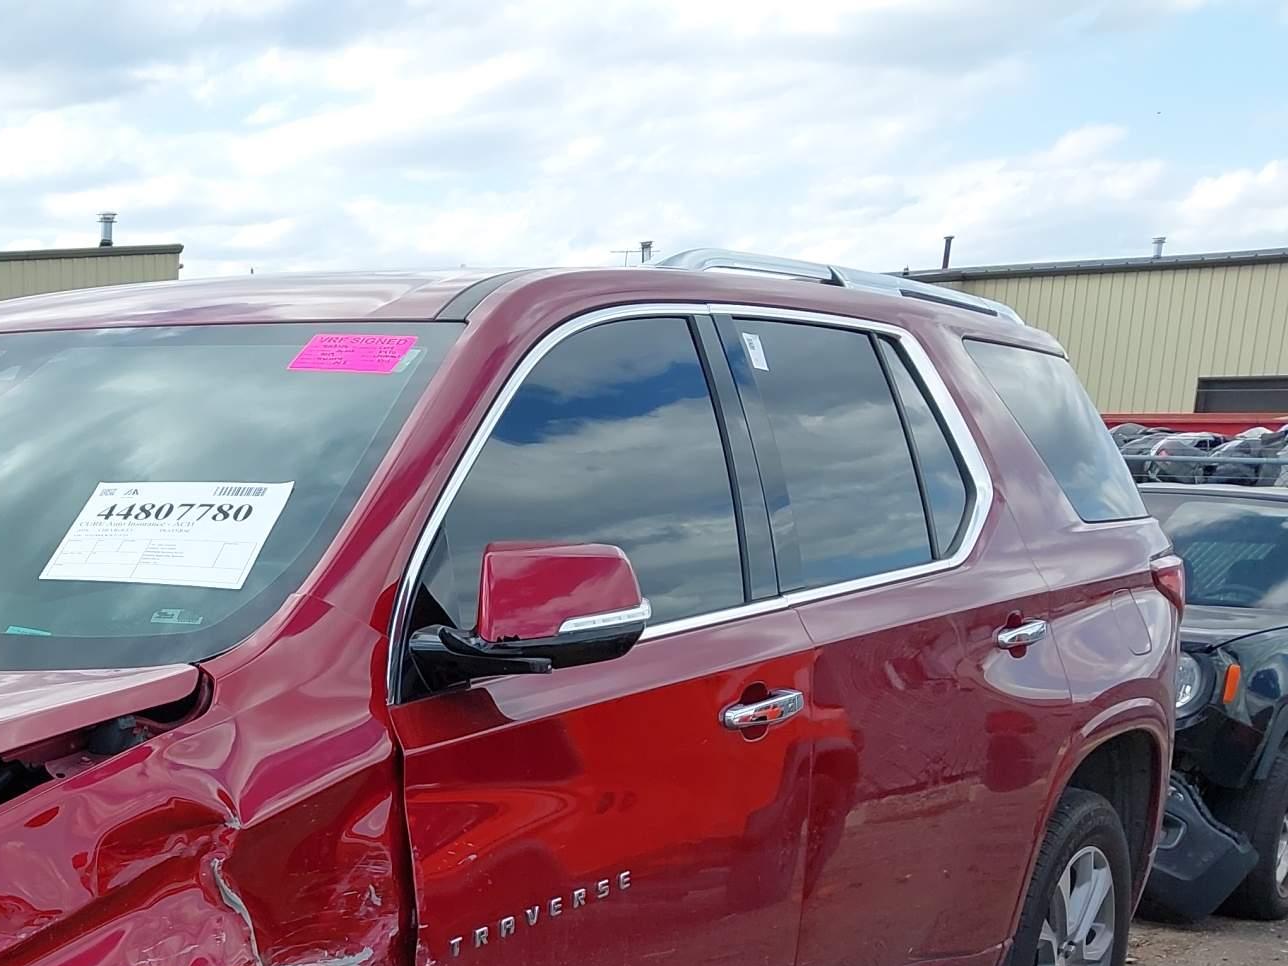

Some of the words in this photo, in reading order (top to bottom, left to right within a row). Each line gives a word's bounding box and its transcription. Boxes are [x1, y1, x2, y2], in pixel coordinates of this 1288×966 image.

[349, 337, 408, 346] SIGNED
[97, 503, 253, 521] 44807780
[449, 870, 632, 957] TRAVERSE
